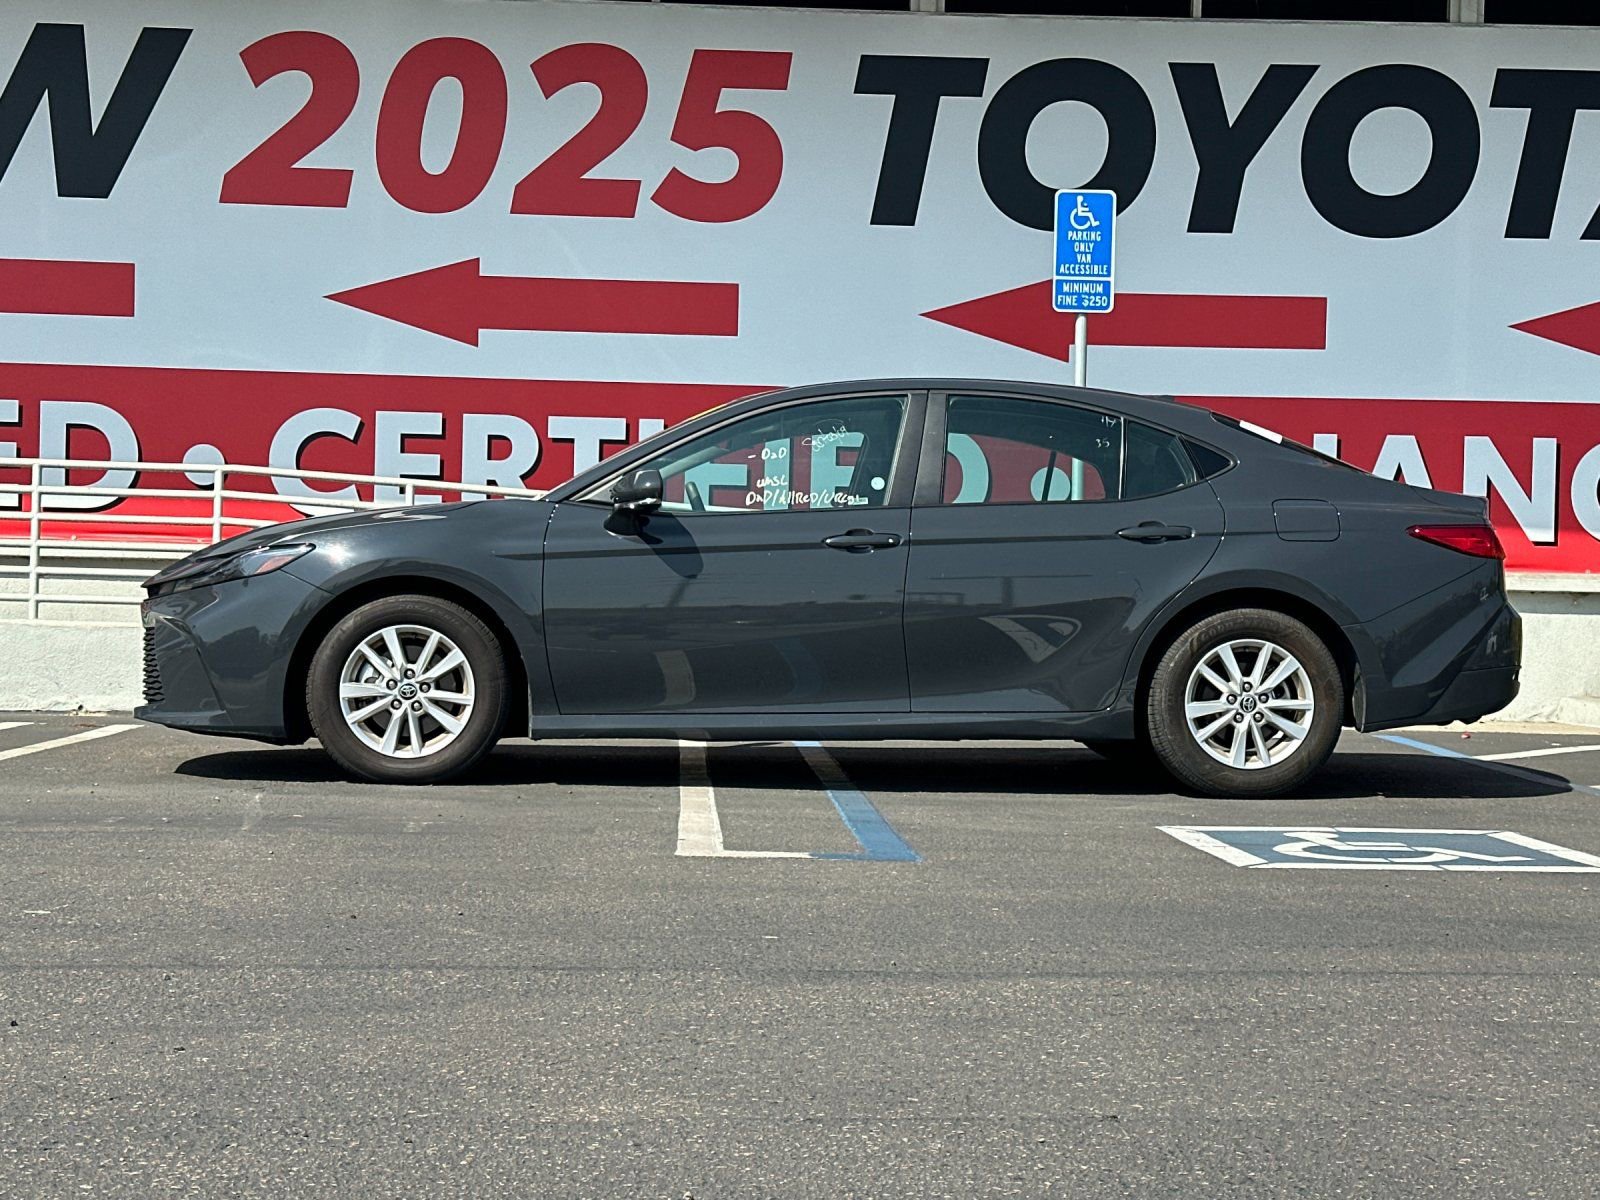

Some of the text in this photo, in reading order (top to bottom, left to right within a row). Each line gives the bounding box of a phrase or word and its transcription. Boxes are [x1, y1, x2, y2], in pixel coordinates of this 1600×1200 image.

[219, 30, 793, 223] 2025
[853, 54, 1600, 240] TOYOT
[1068, 231, 1102, 241] PARKING
[1074, 242, 1095, 252] ONLY
[1077, 254, 1091, 263] VAN
[1059, 264, 1108, 275] ACCESSIBLE
[1062, 282, 1103, 293] MINIMUM
[1057, 295, 1108, 307] FINE $250
